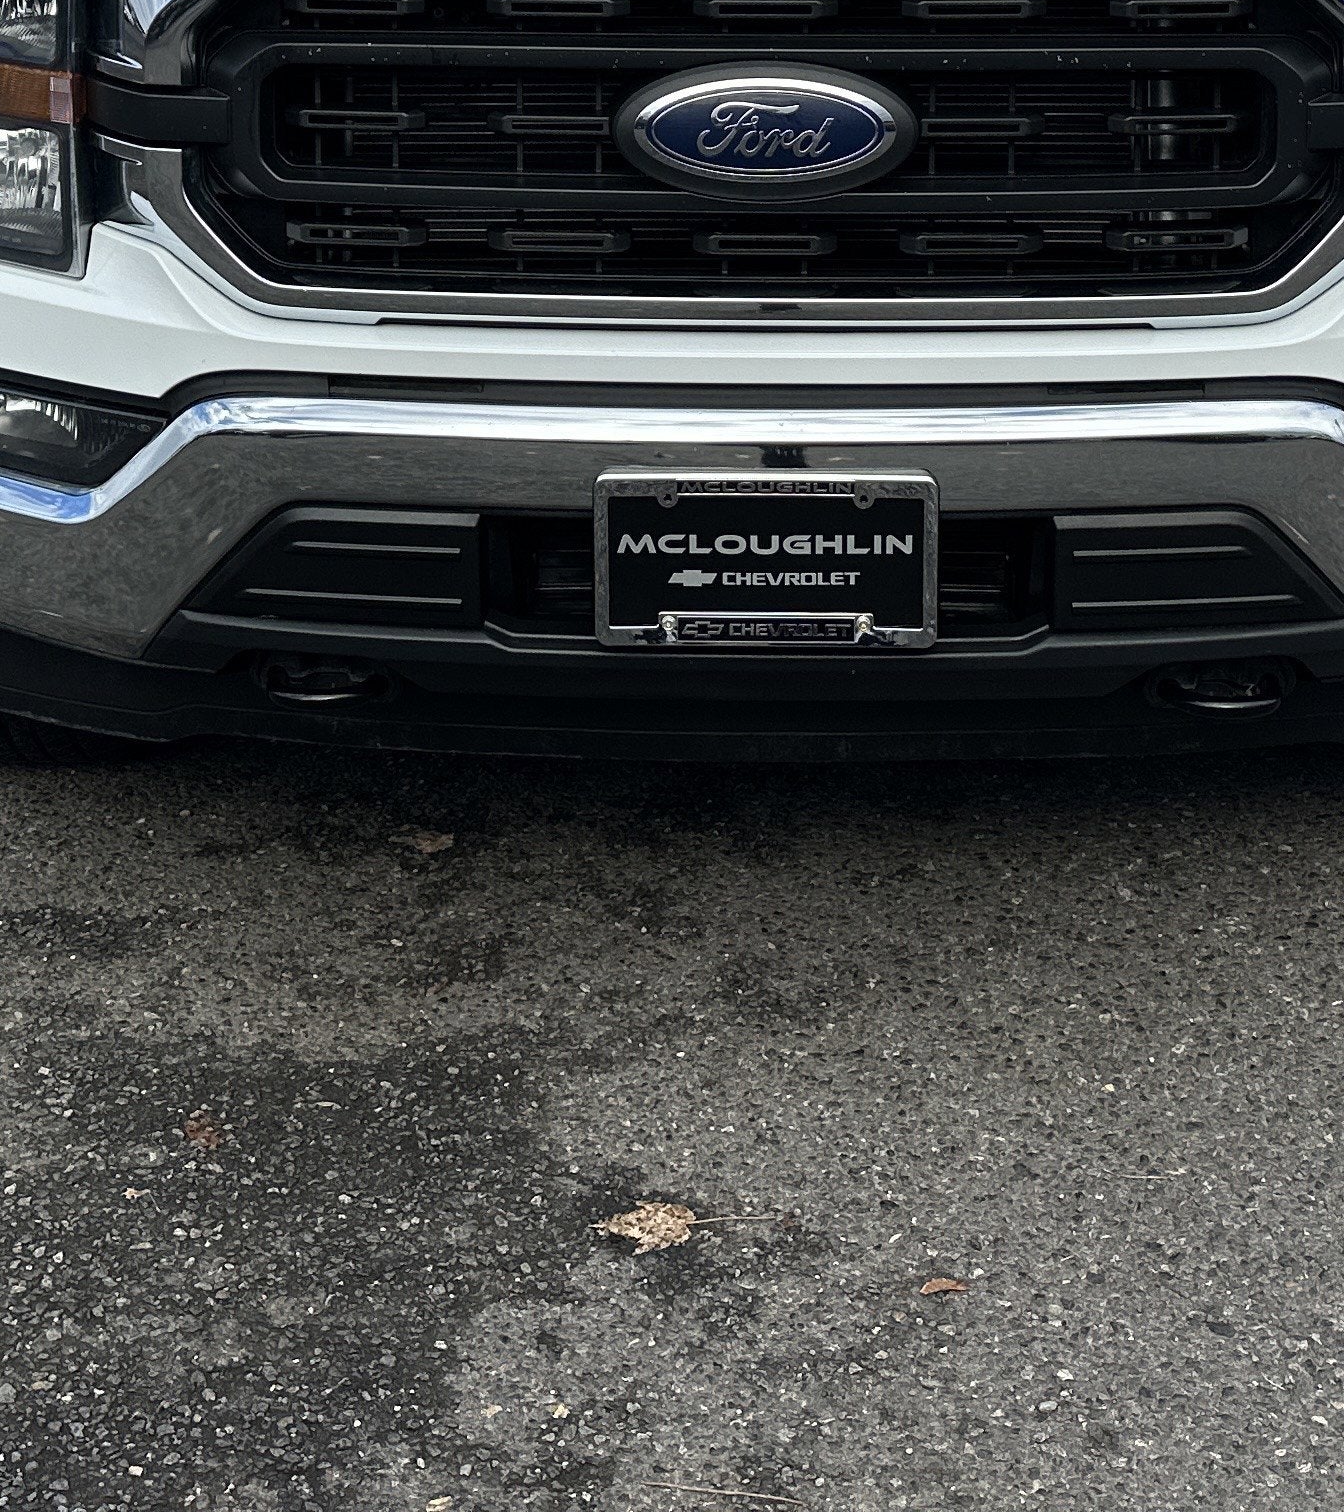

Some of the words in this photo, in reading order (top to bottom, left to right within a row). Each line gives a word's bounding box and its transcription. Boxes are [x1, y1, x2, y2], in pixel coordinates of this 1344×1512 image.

[696, 101, 834, 158] Ford
[681, 481, 852, 493] MCLOUGHLIN
[617, 534, 913, 555] MCLOUGHLIN
[722, 571, 861, 586] CHEVROLET
[729, 623, 852, 637] CHEVROLET
